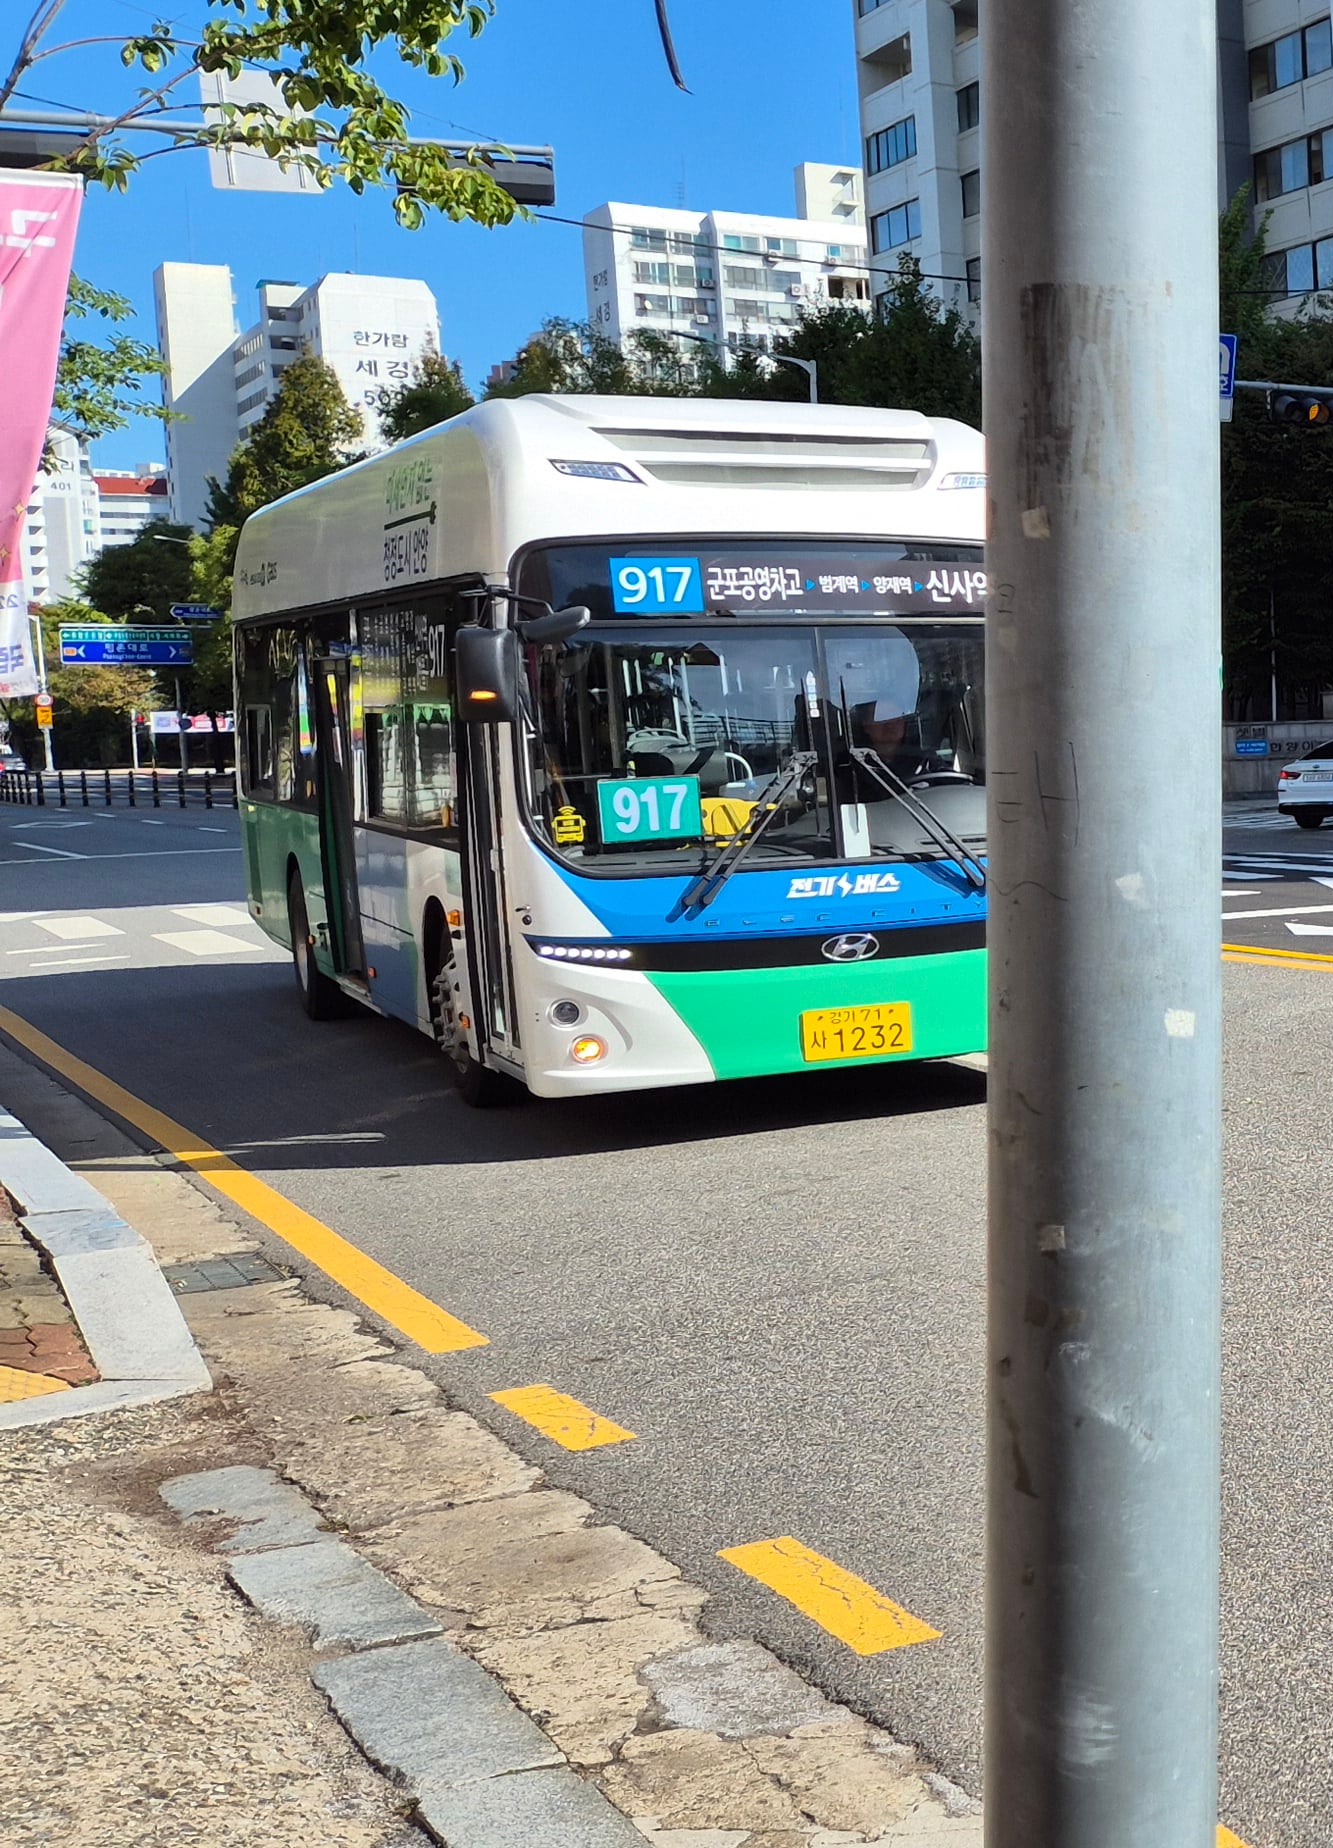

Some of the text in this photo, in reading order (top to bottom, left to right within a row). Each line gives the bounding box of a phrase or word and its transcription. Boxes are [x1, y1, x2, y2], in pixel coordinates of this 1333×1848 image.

[353, 330, 409, 348] 한가람
[356, 359, 409, 379] 세경
[616, 565, 693, 605] 917
[707, 566, 804, 601] 군포공영차고
[818, 574, 860, 594] 범계역
[873, 575, 913, 595] 양재역
[429, 624, 445, 678] 917
[612, 783, 690, 834] 917
[829, 1008, 881, 1025] 경기71
[811, 1023, 904, 1053] 사1232
